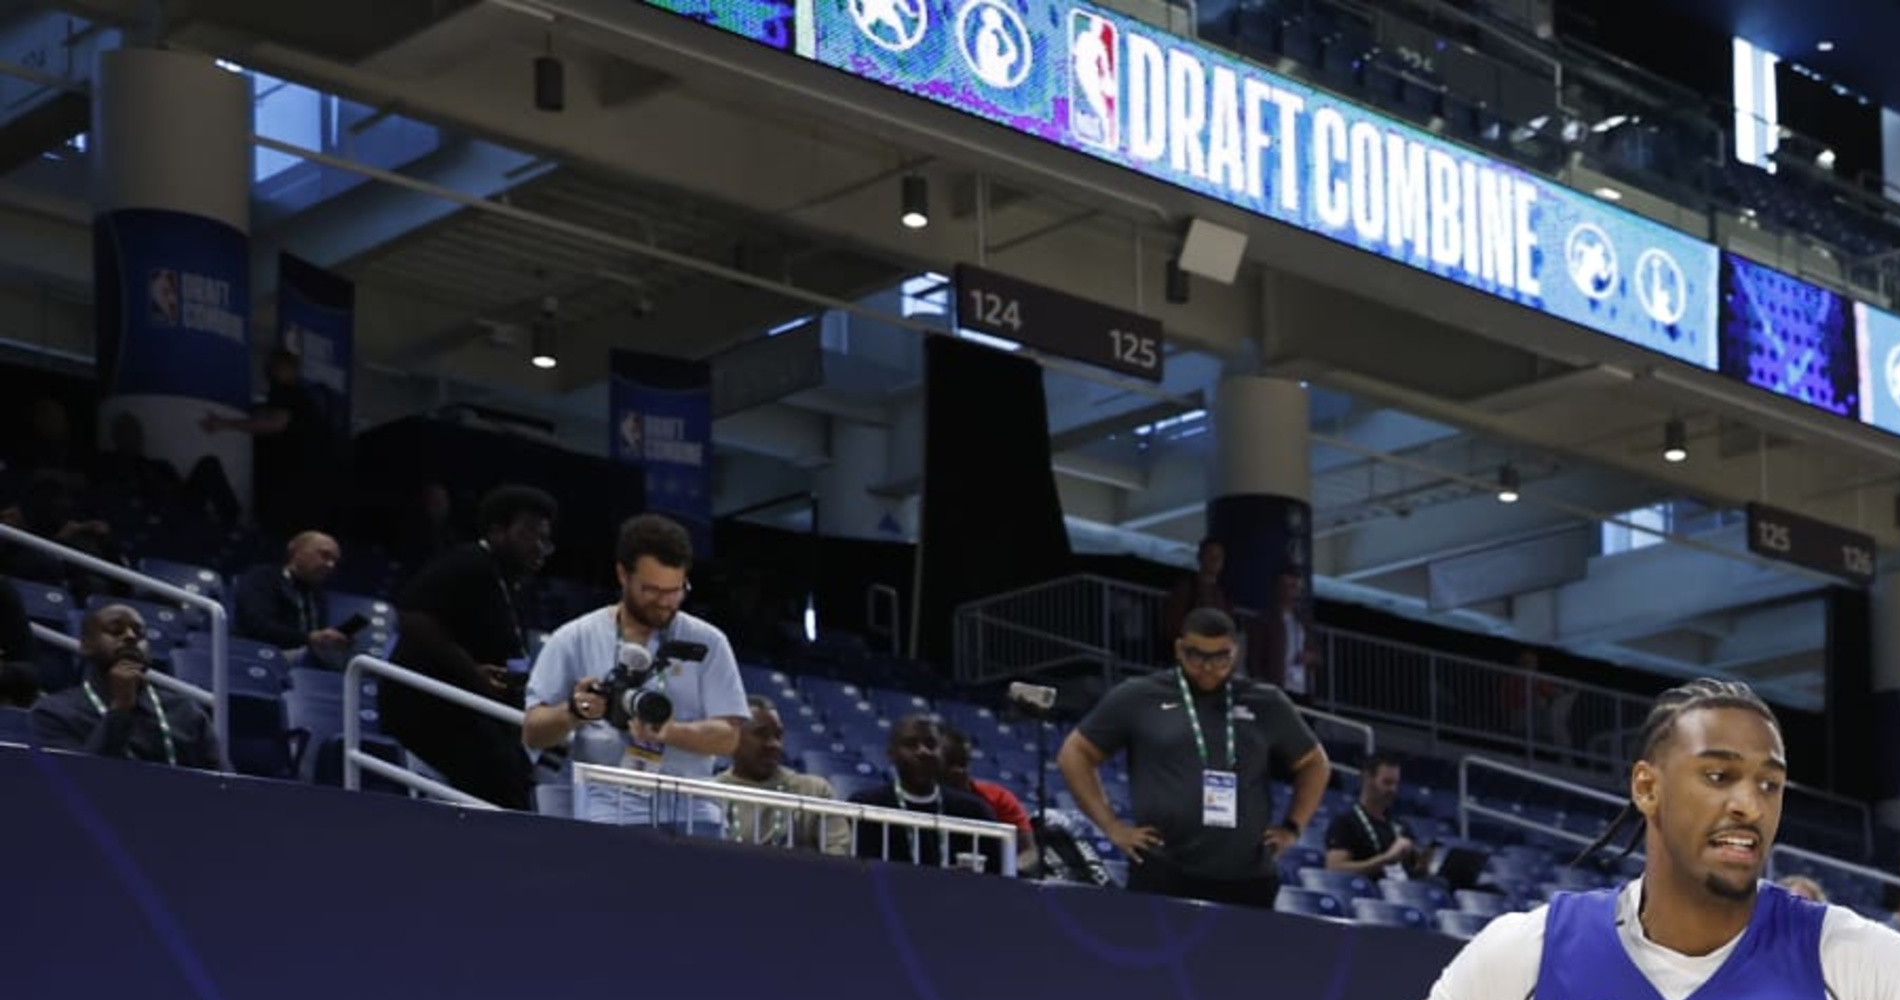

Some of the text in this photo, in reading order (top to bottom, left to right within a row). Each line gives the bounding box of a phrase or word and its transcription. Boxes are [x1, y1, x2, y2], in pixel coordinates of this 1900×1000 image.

[1127, 32, 1542, 296] DRAFT COMBINE
[970, 290, 1156, 368] 124 125
[1758, 521, 1874, 576] 125 126
